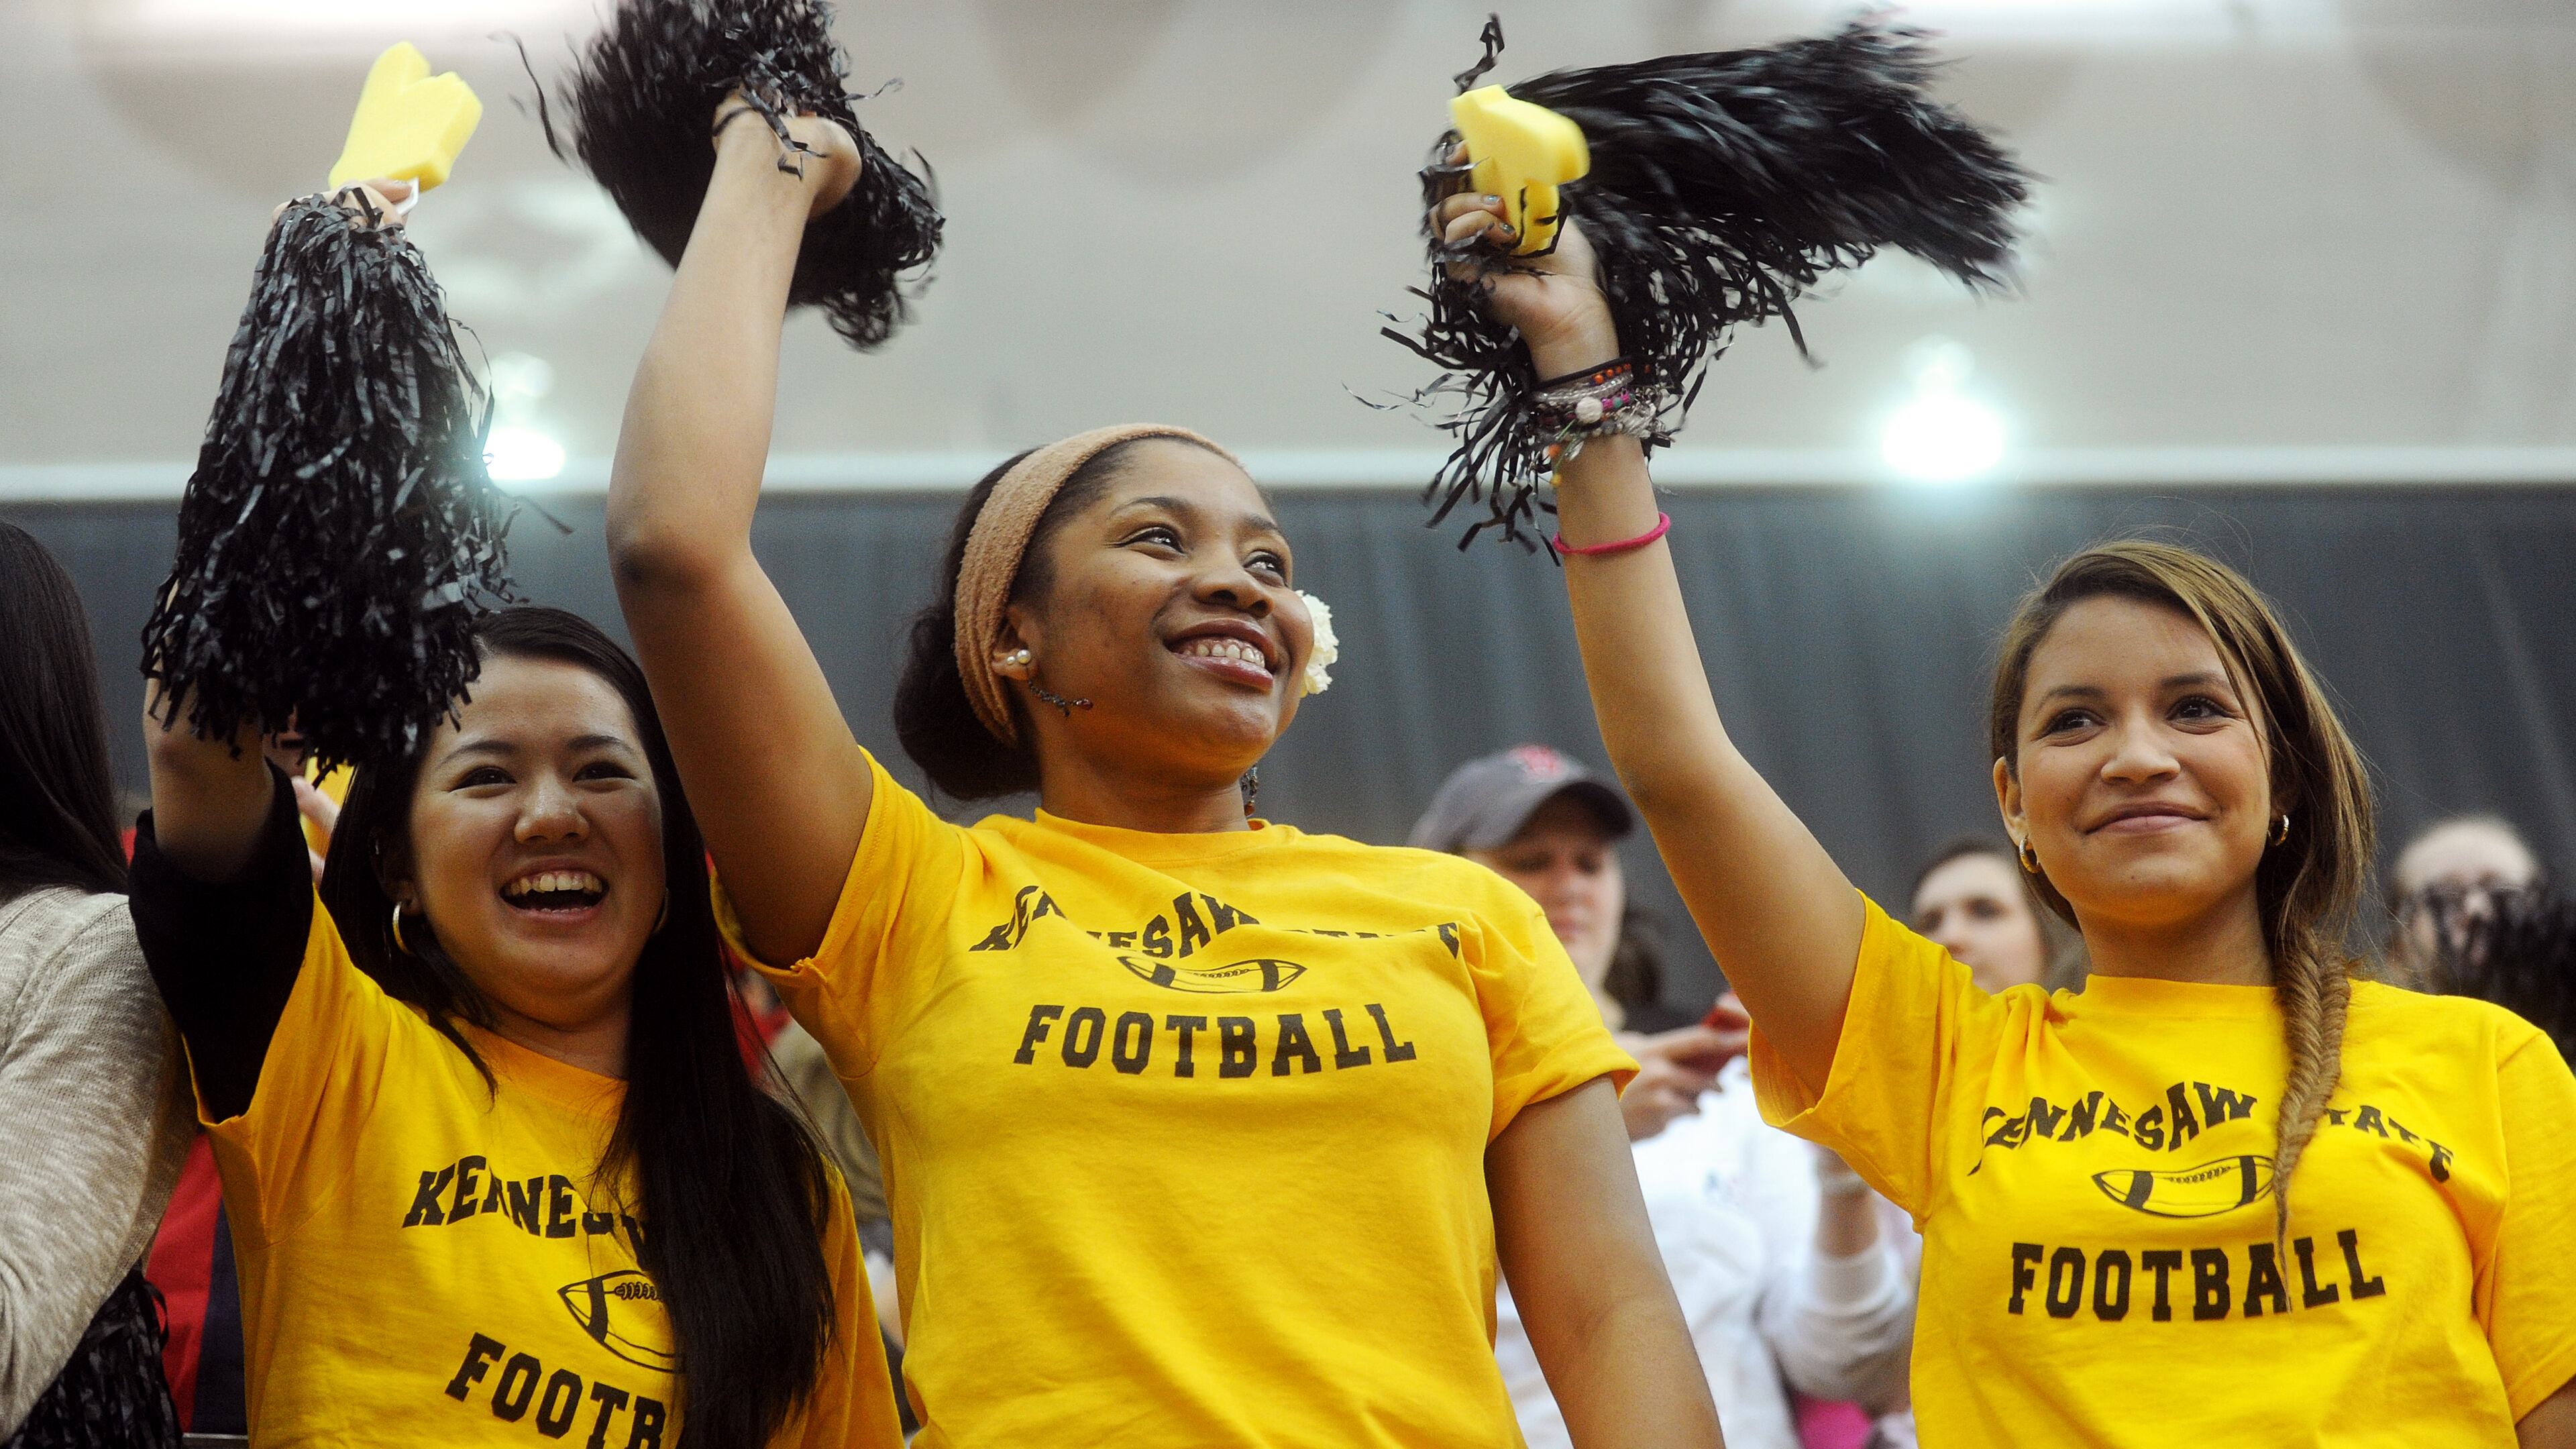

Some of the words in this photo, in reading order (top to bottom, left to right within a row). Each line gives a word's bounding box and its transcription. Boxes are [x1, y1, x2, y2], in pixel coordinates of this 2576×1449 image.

[1013, 1003, 1417, 1079] FOOTBALL
[2323, 1105, 2453, 1183] TATE
[2008, 1229, 2386, 1322] FOOTBALL
[444, 1332, 667, 1449] FOOTB
